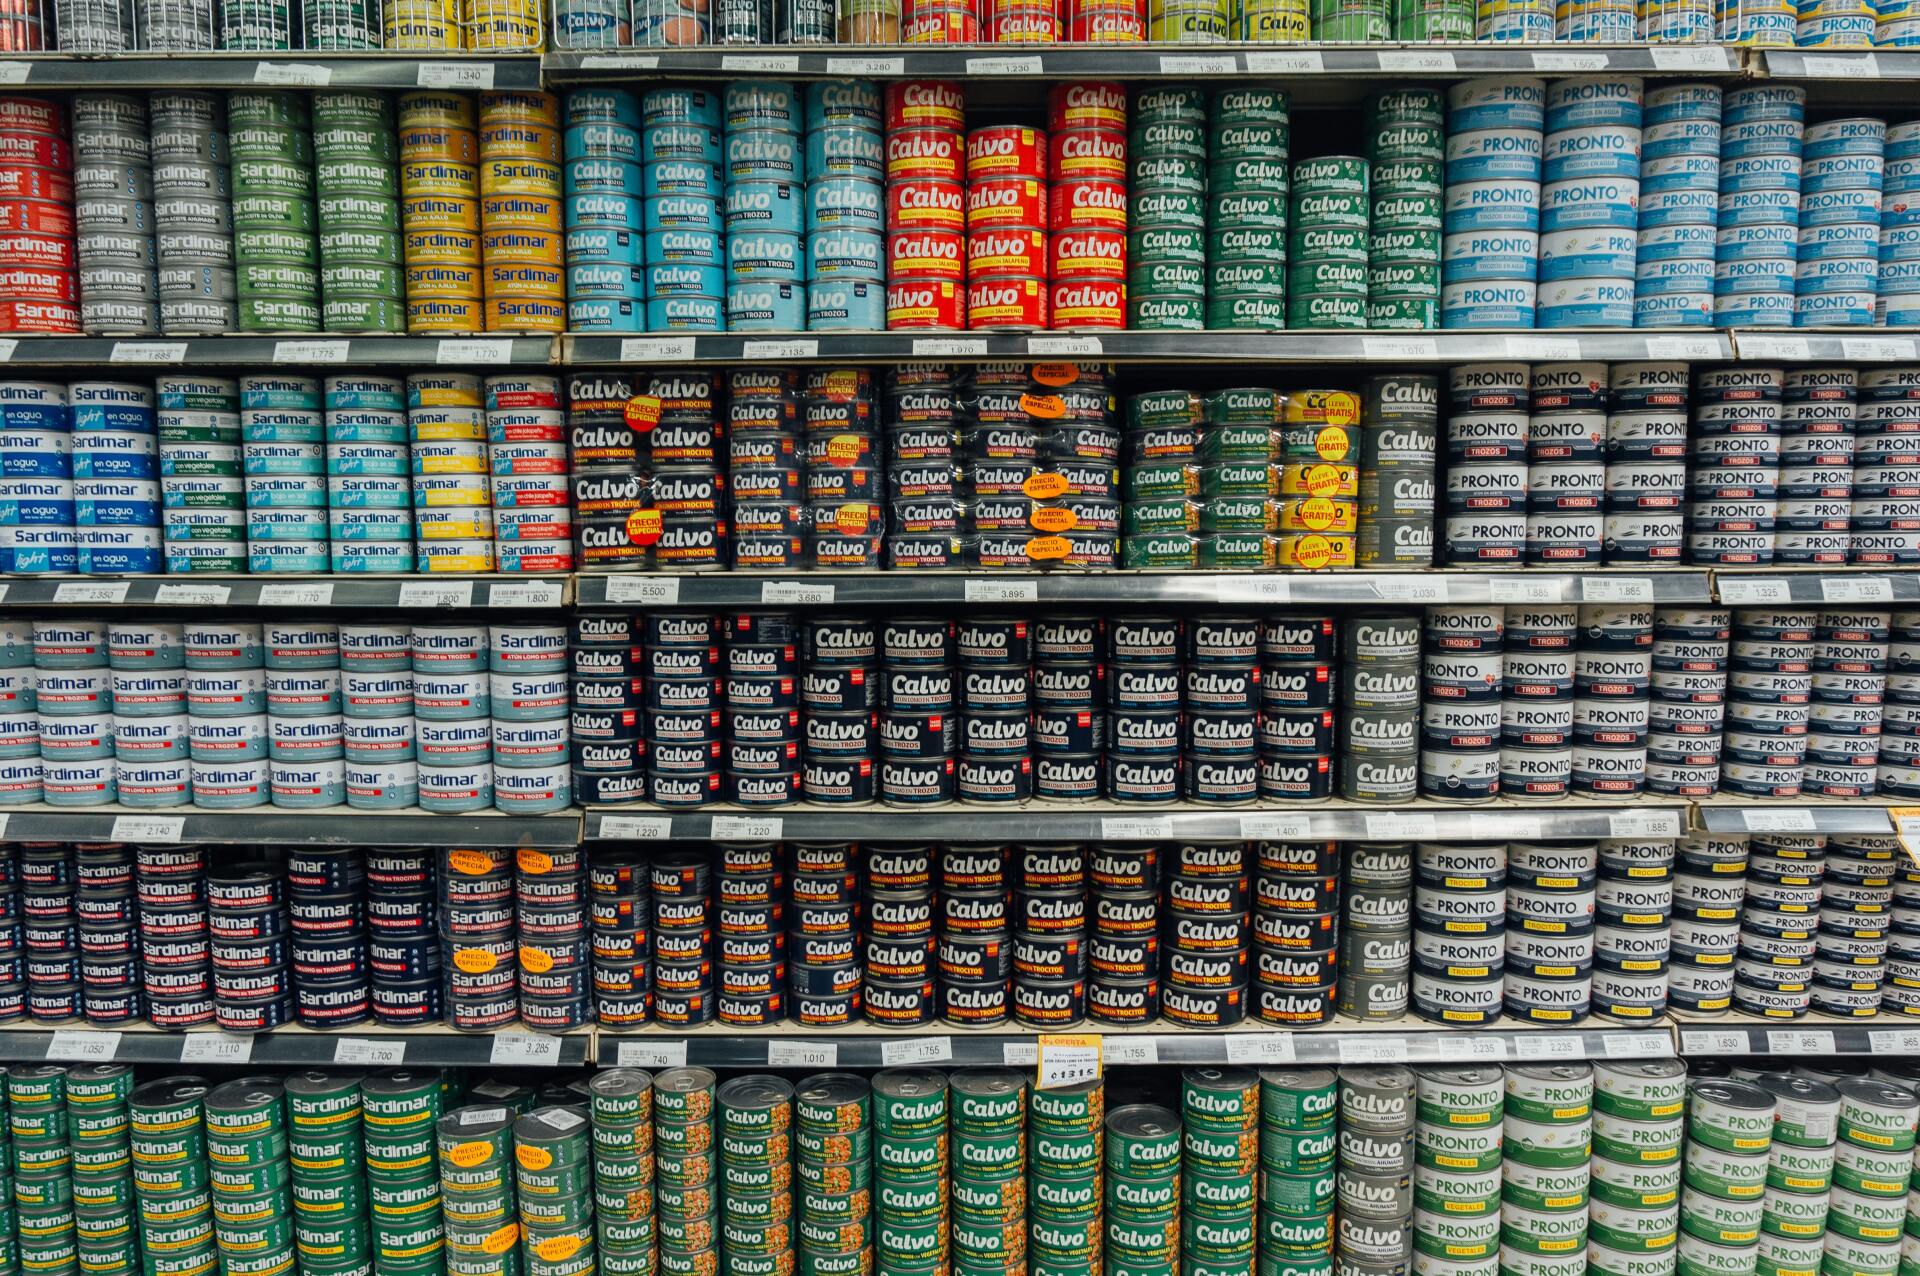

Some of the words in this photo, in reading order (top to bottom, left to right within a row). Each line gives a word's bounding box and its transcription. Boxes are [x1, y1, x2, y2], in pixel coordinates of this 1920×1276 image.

[1000, 16, 1051, 34] Calvo
[1822, 16, 1873, 33] PRONTO
[760, 62, 785, 70] 3.470
[866, 63, 890, 72] 3.280
[1006, 64, 1029, 72] 1.230
[457, 71, 480, 80] 1.340
[730, 140, 791, 160] Calvo
[890, 136, 950, 160] Calvo
[1062, 137, 1123, 158] Calvo
[1484, 138, 1539, 152] PRONTO
[766, 160, 792, 170] TROZOS
[406, 166, 474, 181] Sardimar
[1372, 163, 1422, 180] Calvo
[1554, 186, 1618, 204] PRONTO
[576, 198, 626, 214] Calvo
[1220, 200, 1269, 214] Calvo
[160, 234, 230, 250] Sardimar
[240, 232, 310, 248] Sardimar
[408, 234, 474, 248] Sardimar
[732, 239, 792, 258] Calvo
[659, 346, 682, 355] 1.395
[780, 348, 804, 356] 2.135
[950, 346, 974, 354] 1.970
[1066, 344, 1089, 352] 1.970
[311, 350, 334, 358] 1.775
[475, 349, 498, 358] 1.770
[1467, 372, 1524, 386] PRONTO
[1716, 374, 1771, 386] PRONTO
[336, 381, 394, 392] Sardimar
[76, 388, 146, 401] Sardimar
[900, 396, 949, 409] Calvo
[629, 404, 659, 414] PRECIO
[1326, 408, 1352, 416] GRATIS
[119, 414, 142, 422] agua
[627, 413, 658, 422] ESPECIAL
[573, 428, 633, 447] Calvo
[496, 448, 548, 458] Sardimar
[1462, 474, 1519, 487] PRONTO
[166, 481, 222, 492] Sardimar
[1030, 482, 1060, 491] ESPECIAL
[196, 494, 226, 502] vegetales
[1303, 511, 1333, 520] GRATIS
[1713, 536, 1766, 549] PRONTO
[642, 587, 665, 596] 5.500
[1001, 590, 1024, 598] 3.895
[1619, 587, 1641, 596] 1.885
[1756, 588, 1778, 597] 1.325
[1859, 586, 1880, 595] 1.325
[296, 593, 319, 602] 1.770
[436, 594, 459, 603] 1.800
[526, 594, 548, 602] 1.800
[798, 593, 821, 602] 3.680
[580, 619, 628, 634] Calvo
[1434, 616, 1491, 629] PRONTO
[342, 633, 411, 647] Sardimar
[884, 628, 943, 648] Calvo
[1356, 626, 1418, 646] Calvo
[1510, 662, 1566, 676] PRONTO
[1522, 686, 1550, 694] TROZOS
[1194, 718, 1252, 738] Calvo
[496, 727, 562, 742] Sardimar
[147, 826, 170, 835] 2.140
[636, 828, 658, 837] 1.220
[748, 827, 770, 836] 1.220
[1276, 827, 1298, 836] 1.400
[458, 853, 485, 862] PRECIO
[724, 850, 771, 865] Calvo
[1438, 856, 1496, 869] PRONTO
[78, 864, 131, 876] Sardimar
[454, 860, 486, 870] ESPECIAL
[1774, 862, 1816, 874] PRONTO
[1692, 887, 1744, 900] PRONTO
[1350, 894, 1408, 914] Calvo
[659, 903, 703, 918] Calvo
[946, 900, 1004, 919] Calvo
[1700, 910, 1732, 918] TROCITOS
[450, 908, 512, 924] Sardimar
[979, 918, 1005, 927] TROCITOS
[1616, 938, 1668, 952] PRONTO
[1054, 1038, 1086, 1046] OFERTA
[1717, 1038, 1738, 1048] 1.630
[82, 1045, 104, 1054] 1.050
[218, 1044, 240, 1054] 1.110
[918, 1046, 940, 1056] 1.755
[1124, 1049, 1146, 1058] 1.755
[371, 1051, 392, 1060] 1.700
[652, 1055, 668, 1064] 740
[803, 1054, 824, 1062] 1.010
[1186, 1089, 1240, 1113] Calvo
[1342, 1088, 1404, 1113] Calvo
[1441, 1091, 1498, 1106] PRONTO
[363, 1096, 430, 1112] Sardimar
[596, 1098, 638, 1112] Calvo
[391, 1114, 422, 1123] VEGETALES
[1069, 1116, 1094, 1124] VEGETALES
[1223, 1114, 1248, 1122] VEGETALES
[1452, 1114, 1488, 1122] VEGETALES
[1846, 1105, 1906, 1127] PRONTO
[1850, 1131, 1892, 1144] VEGETALES
[455, 1144, 482, 1156] PRECIO
[453, 1152, 487, 1162] ESPECIAL
